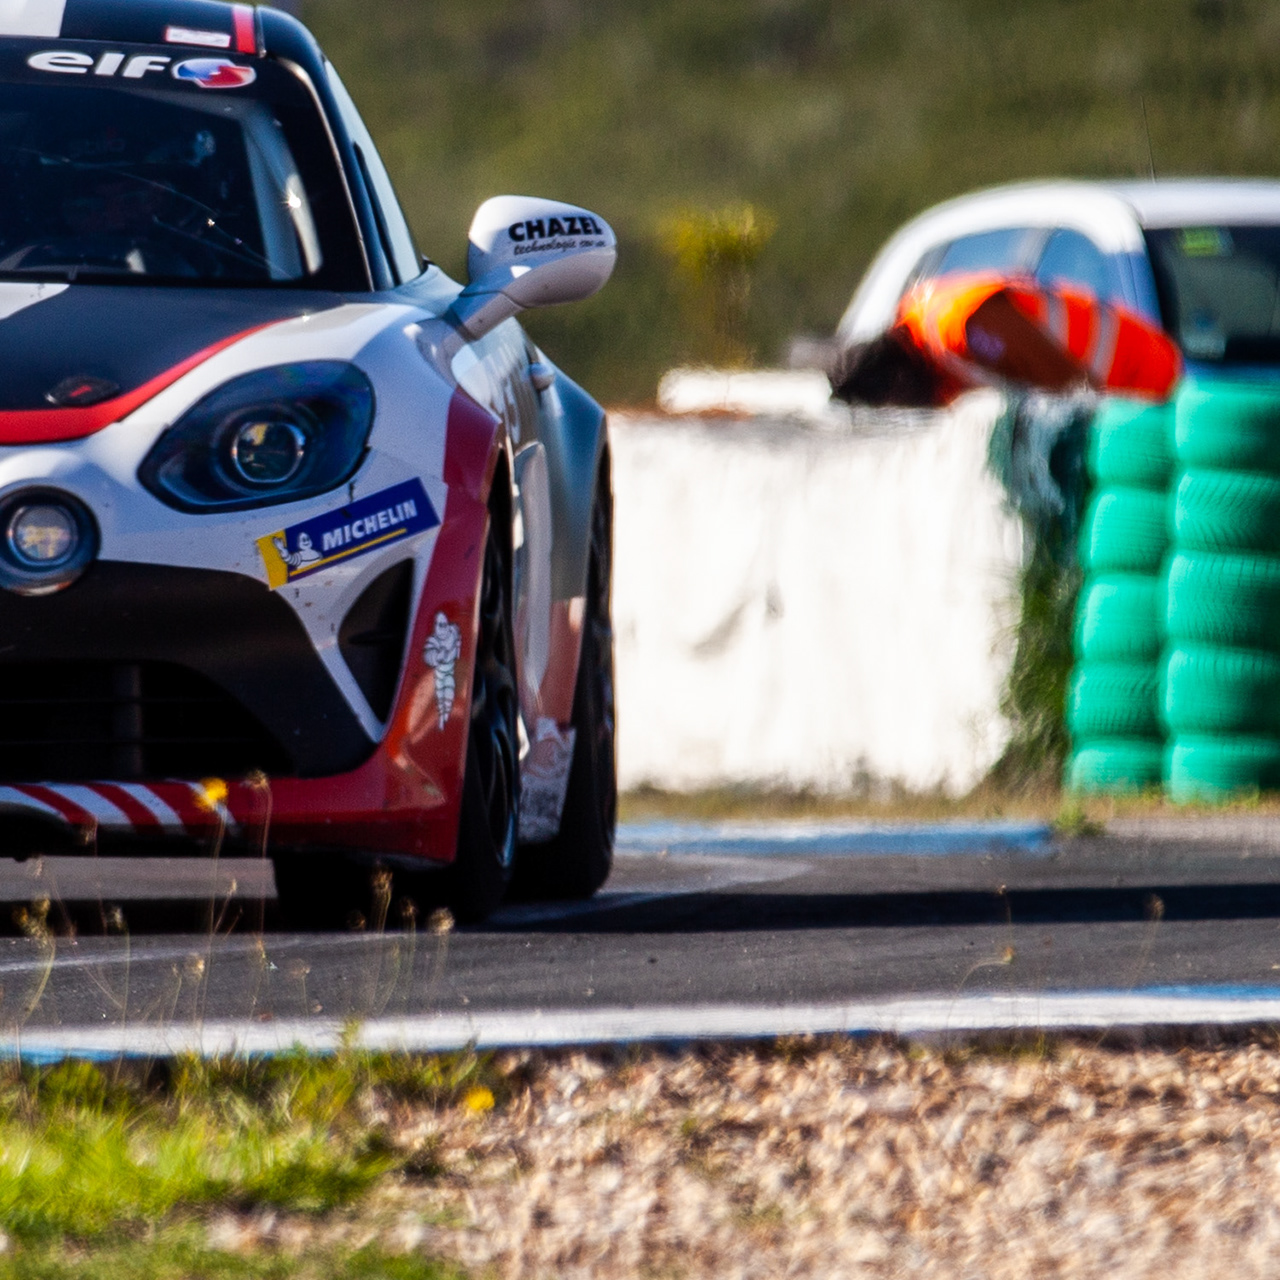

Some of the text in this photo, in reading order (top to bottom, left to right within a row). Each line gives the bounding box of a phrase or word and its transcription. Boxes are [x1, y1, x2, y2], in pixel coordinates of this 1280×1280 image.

[27, 51, 171, 78] elf
[508, 216, 603, 242] CHAZEL
[514, 239, 576, 256] technologie
[322, 498, 417, 552] MICHELIN
